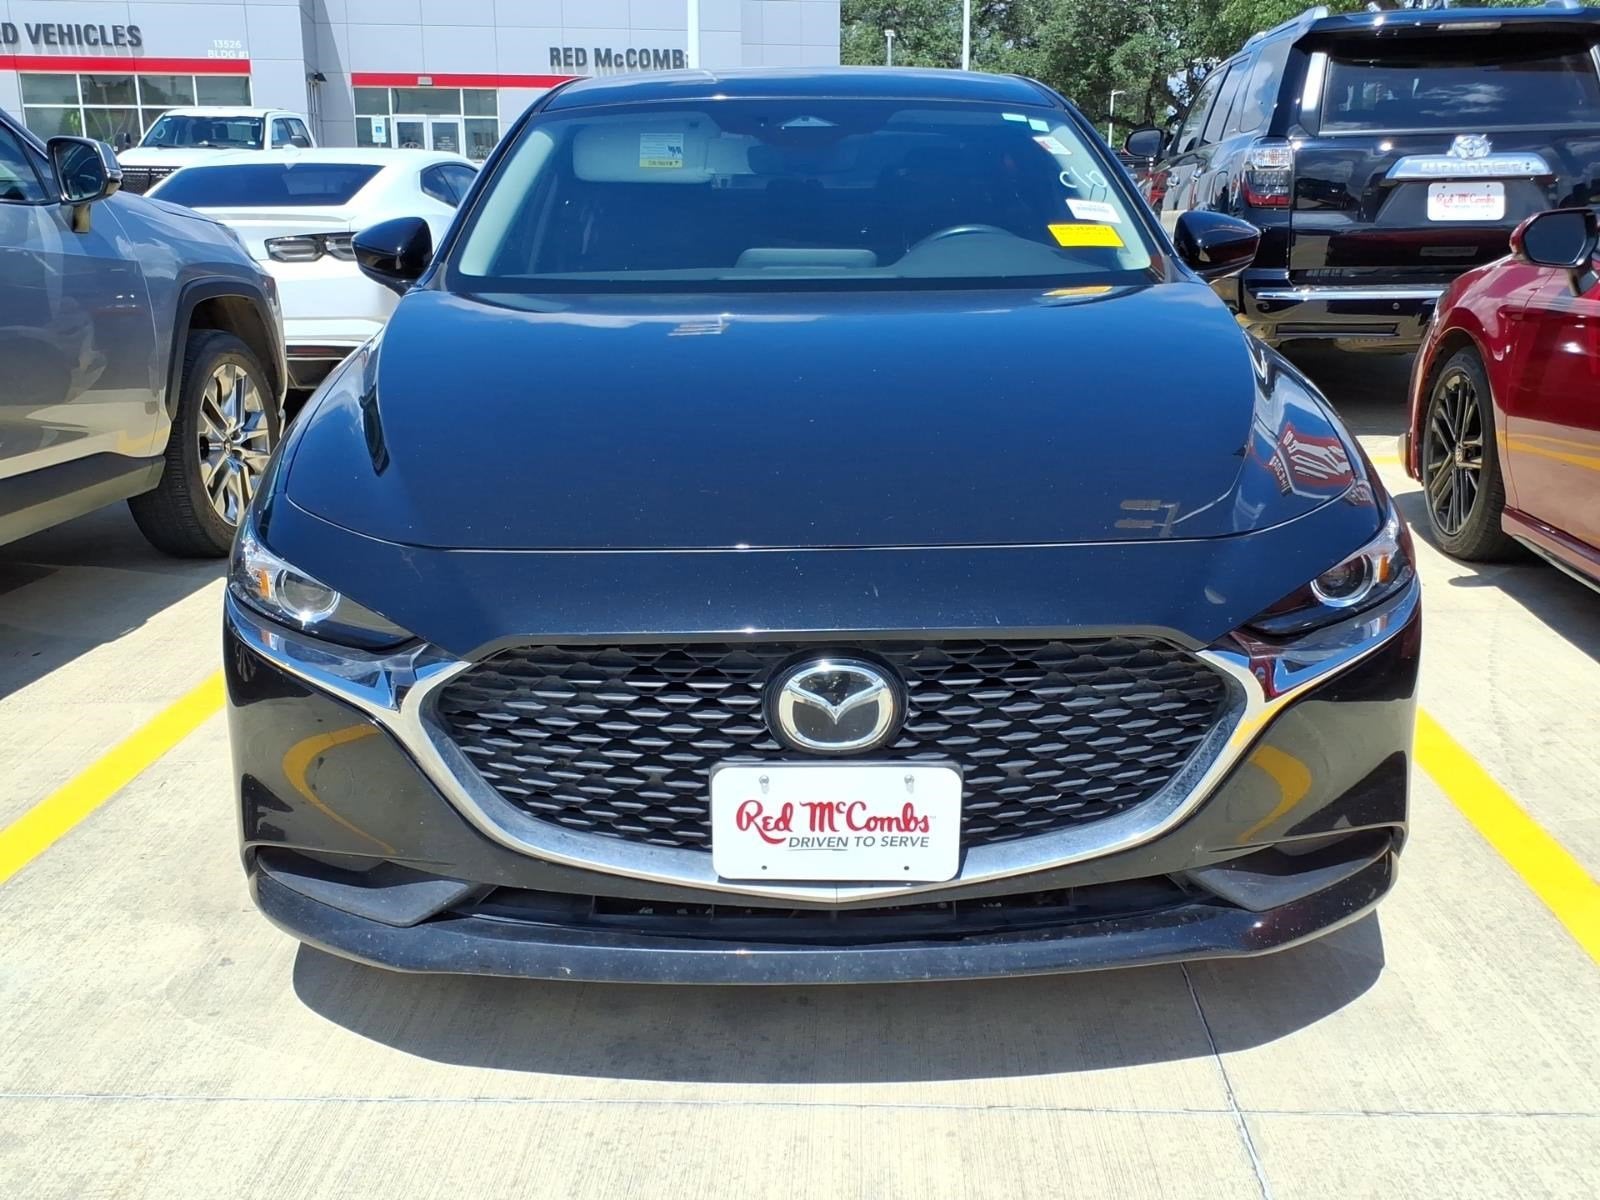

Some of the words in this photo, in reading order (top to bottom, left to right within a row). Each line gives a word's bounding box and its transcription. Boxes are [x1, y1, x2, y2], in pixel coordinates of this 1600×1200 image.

[24, 23, 142, 47] VEHICLES
[213, 39, 241, 48] 13526
[208, 49, 236, 58] BLDG
[549, 47, 587, 67] RED
[594, 48, 688, 69] McCOMB
[736, 800, 793, 844] Red
[800, 801, 929, 833] McCombs
[788, 836, 848, 848] DRIVEN
[854, 836, 875, 847] TO
[880, 836, 929, 848] SERVE
